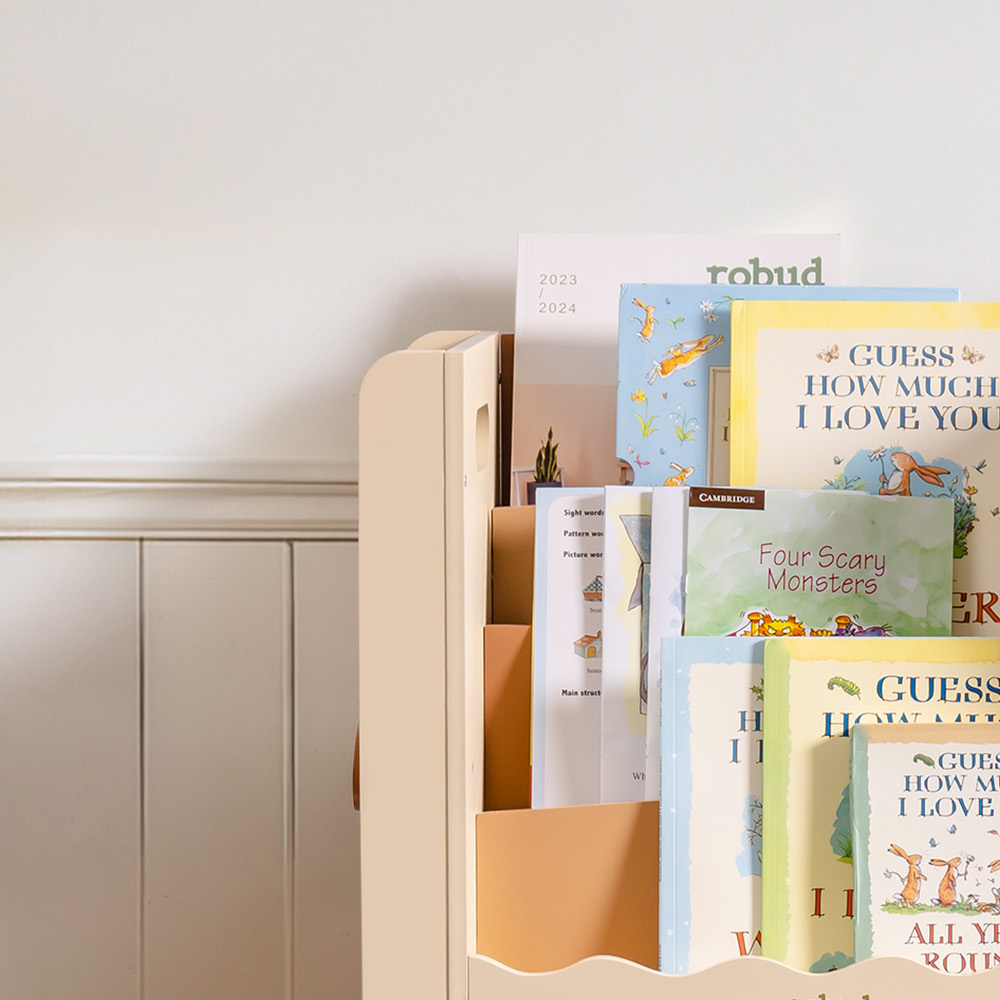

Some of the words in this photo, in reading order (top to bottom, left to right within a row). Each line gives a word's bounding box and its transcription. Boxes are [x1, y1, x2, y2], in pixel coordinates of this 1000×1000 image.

[538, 273, 578, 286] 2023
[706, 256, 826, 286] robud
[538, 302, 577, 314] 2024
[849, 343, 955, 368] GUESS
[804, 374, 887, 397] HOW
[895, 375, 1000, 398] MUCH
[796, 404, 808, 430] I
[822, 404, 920, 431] LOVE
[563, 508, 582, 518] Sight
[563, 550, 588, 558] Picture
[759, 542, 812, 567] Four
[818, 545, 886, 577] Scary
[767, 567, 878, 595] Monsters
[561, 688, 579, 697] Main
[903, 774, 967, 792] HOW
[897, 797, 907, 817] I
[917, 797, 995, 818] LOVE
[904, 922, 964, 946] ALL
